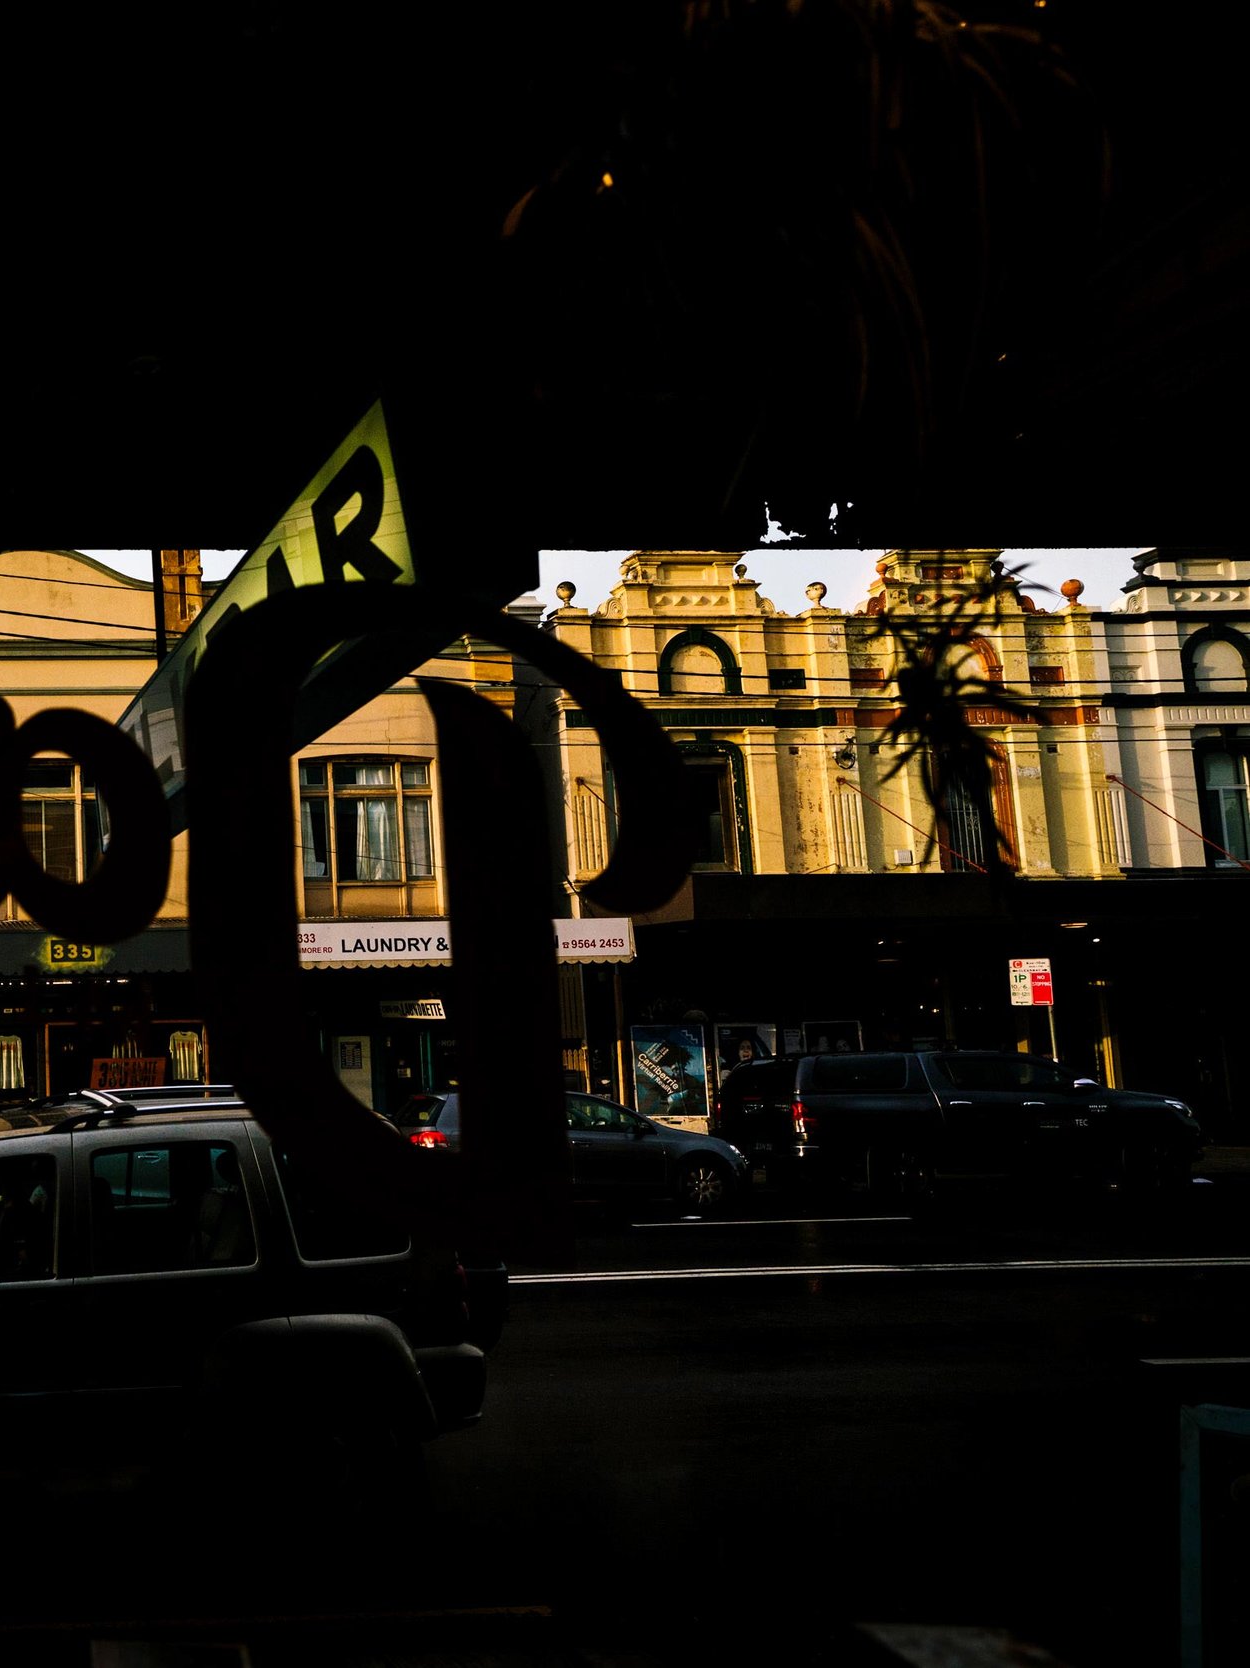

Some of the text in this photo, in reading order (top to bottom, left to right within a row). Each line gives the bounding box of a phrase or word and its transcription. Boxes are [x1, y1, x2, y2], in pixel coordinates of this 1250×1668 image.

[297, 933, 316, 944] 333
[341, 937, 449, 953] LAUNDRY &
[571, 939, 596, 949] 9564
[599, 938, 625, 948] 2453
[53, 944, 92, 959] 335
[637, 1061, 657, 1080] Virtual
[638, 1053, 679, 1090] Carriberrie
